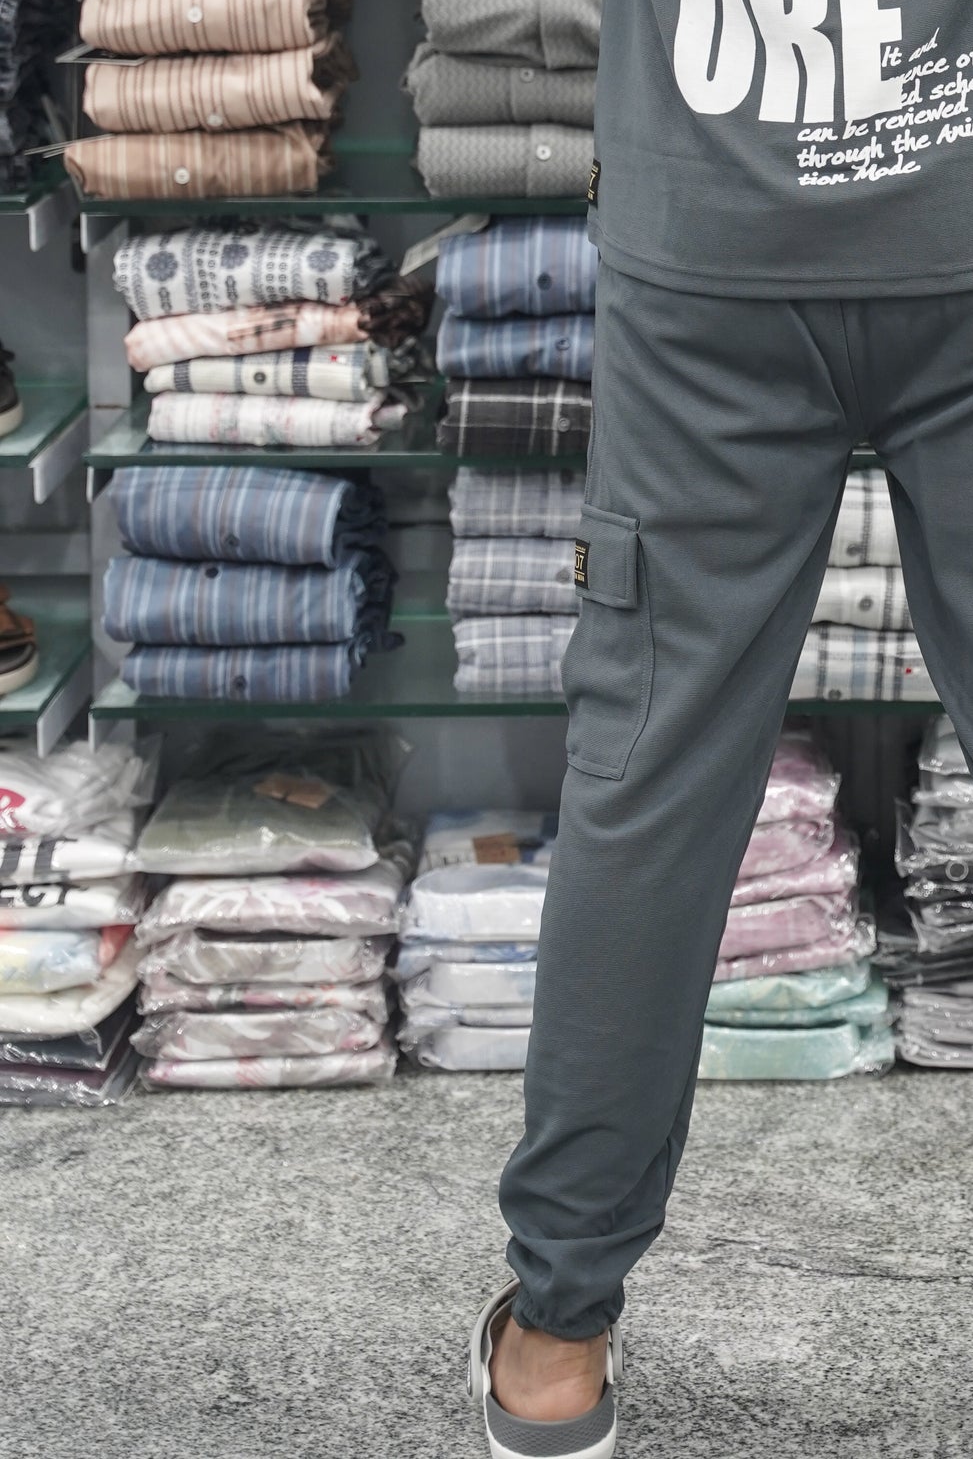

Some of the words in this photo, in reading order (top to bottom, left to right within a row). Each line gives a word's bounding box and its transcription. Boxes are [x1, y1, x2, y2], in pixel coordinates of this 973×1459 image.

[881, 45, 903, 68] It
[908, 26, 940, 63] and
[796, 126, 839, 142] can
[842, 118, 870, 140] be
[874, 96, 969, 132] reviewed
[796, 135, 885, 170] through
[891, 128, 931, 154] the
[798, 171, 850, 186] tion
[851, 153, 922, 182] Mode
